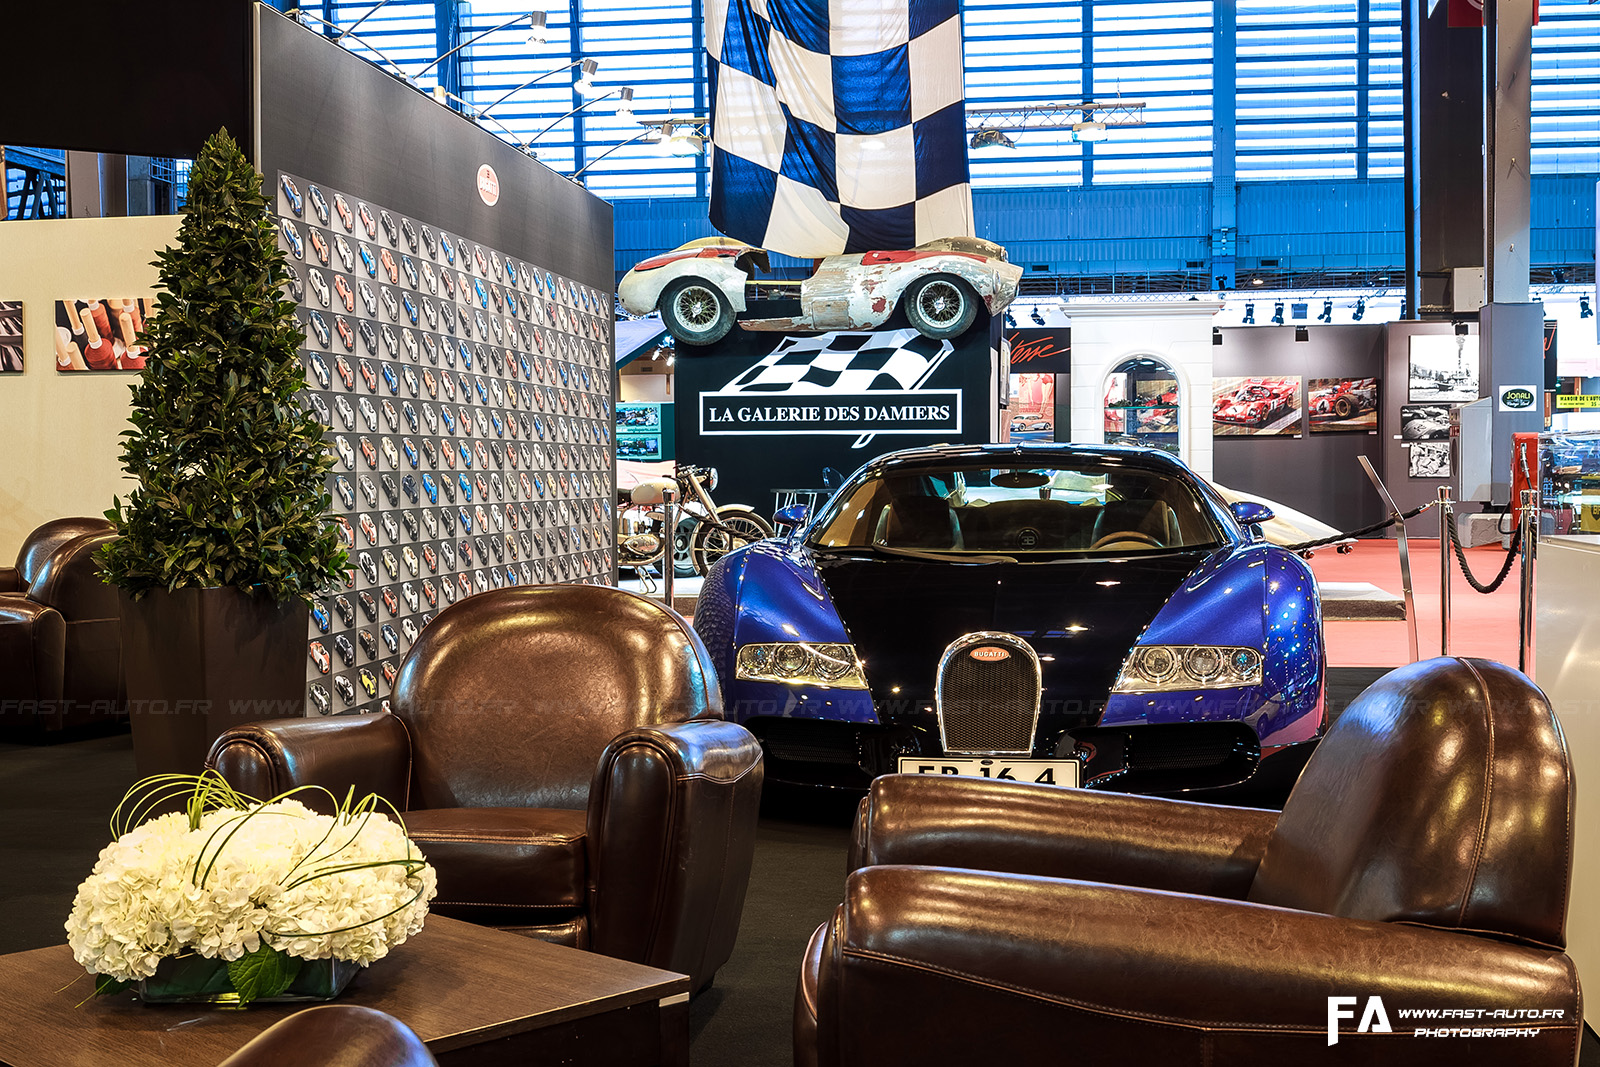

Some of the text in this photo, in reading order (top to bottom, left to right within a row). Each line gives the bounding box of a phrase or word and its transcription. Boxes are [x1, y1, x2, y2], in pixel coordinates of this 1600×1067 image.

[709, 405, 950, 422] LA GALERIE DES DAMIERS
